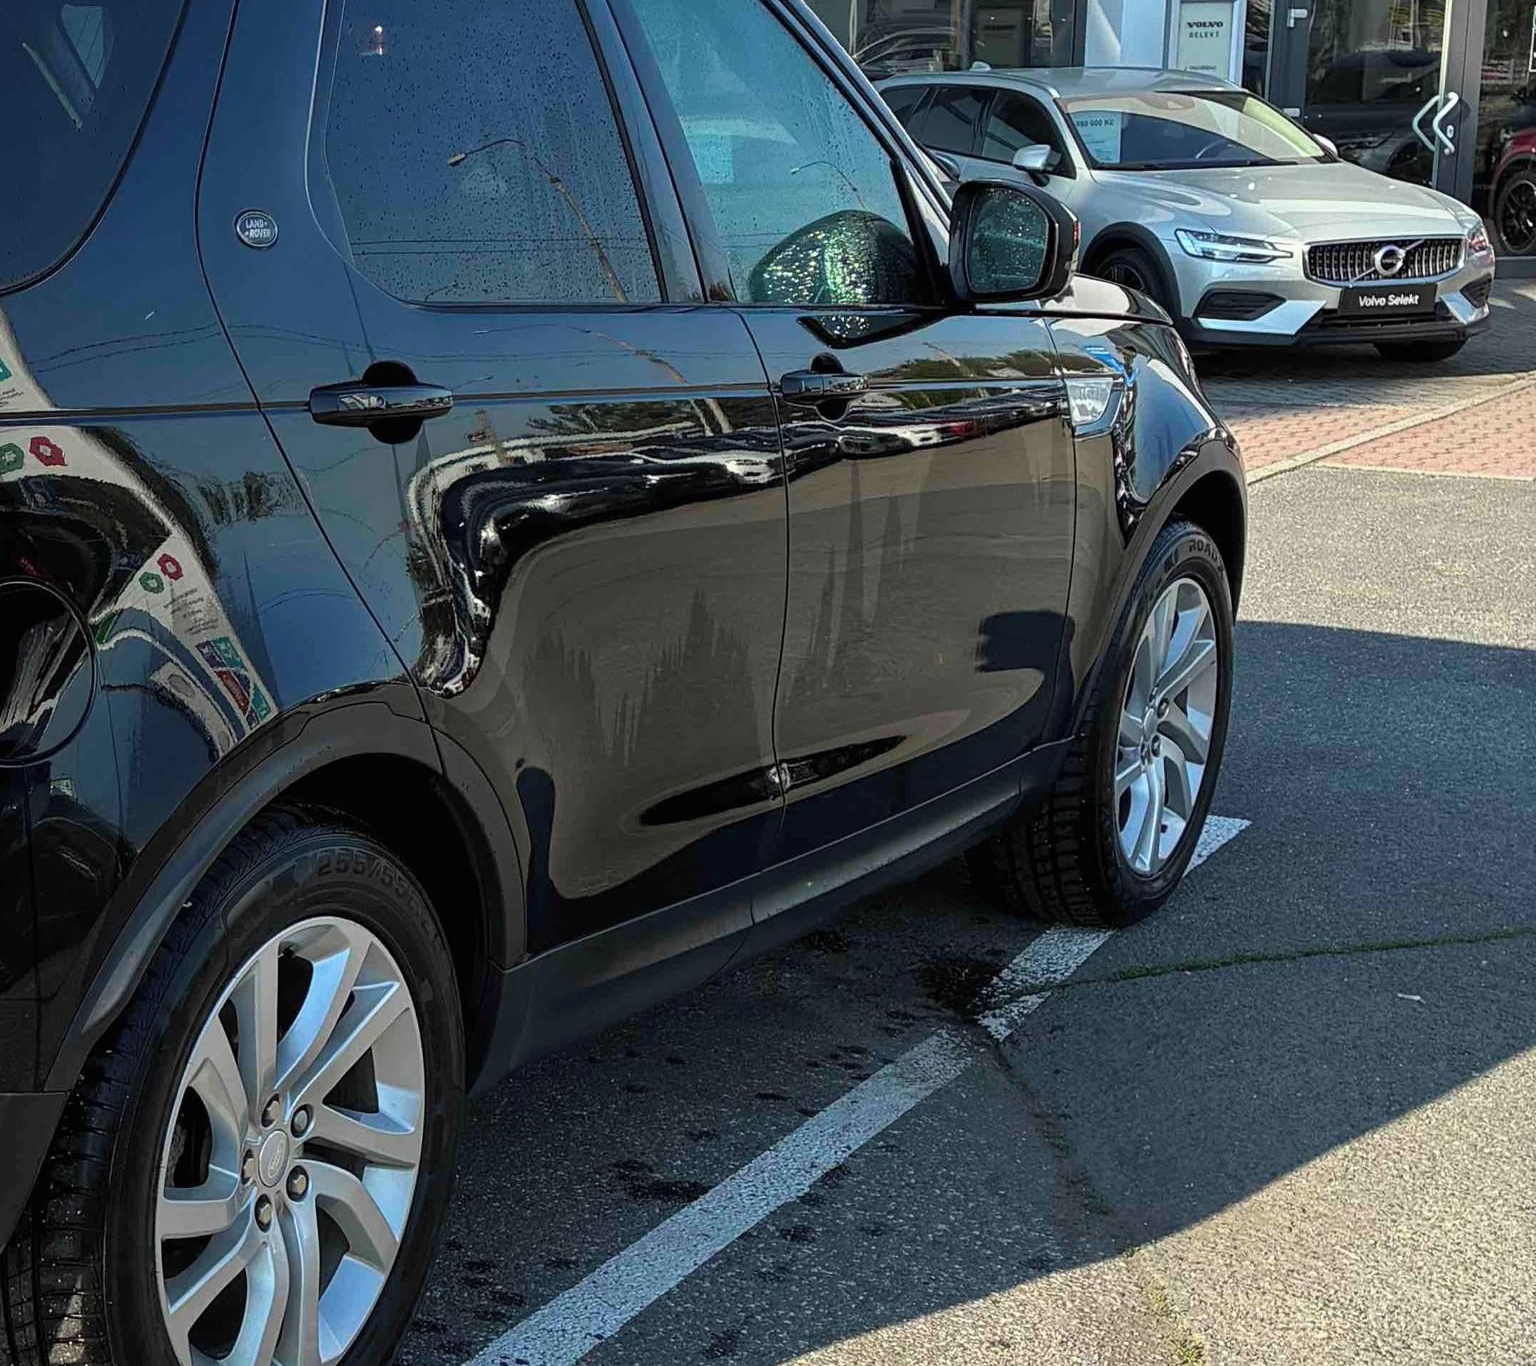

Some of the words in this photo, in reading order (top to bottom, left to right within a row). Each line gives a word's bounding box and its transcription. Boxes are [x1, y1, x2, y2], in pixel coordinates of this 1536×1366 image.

[1186, 20, 1224, 28] VOLVO
[1358, 295, 1386, 307] Volvo
[1387, 294, 1420, 306] Selekt
